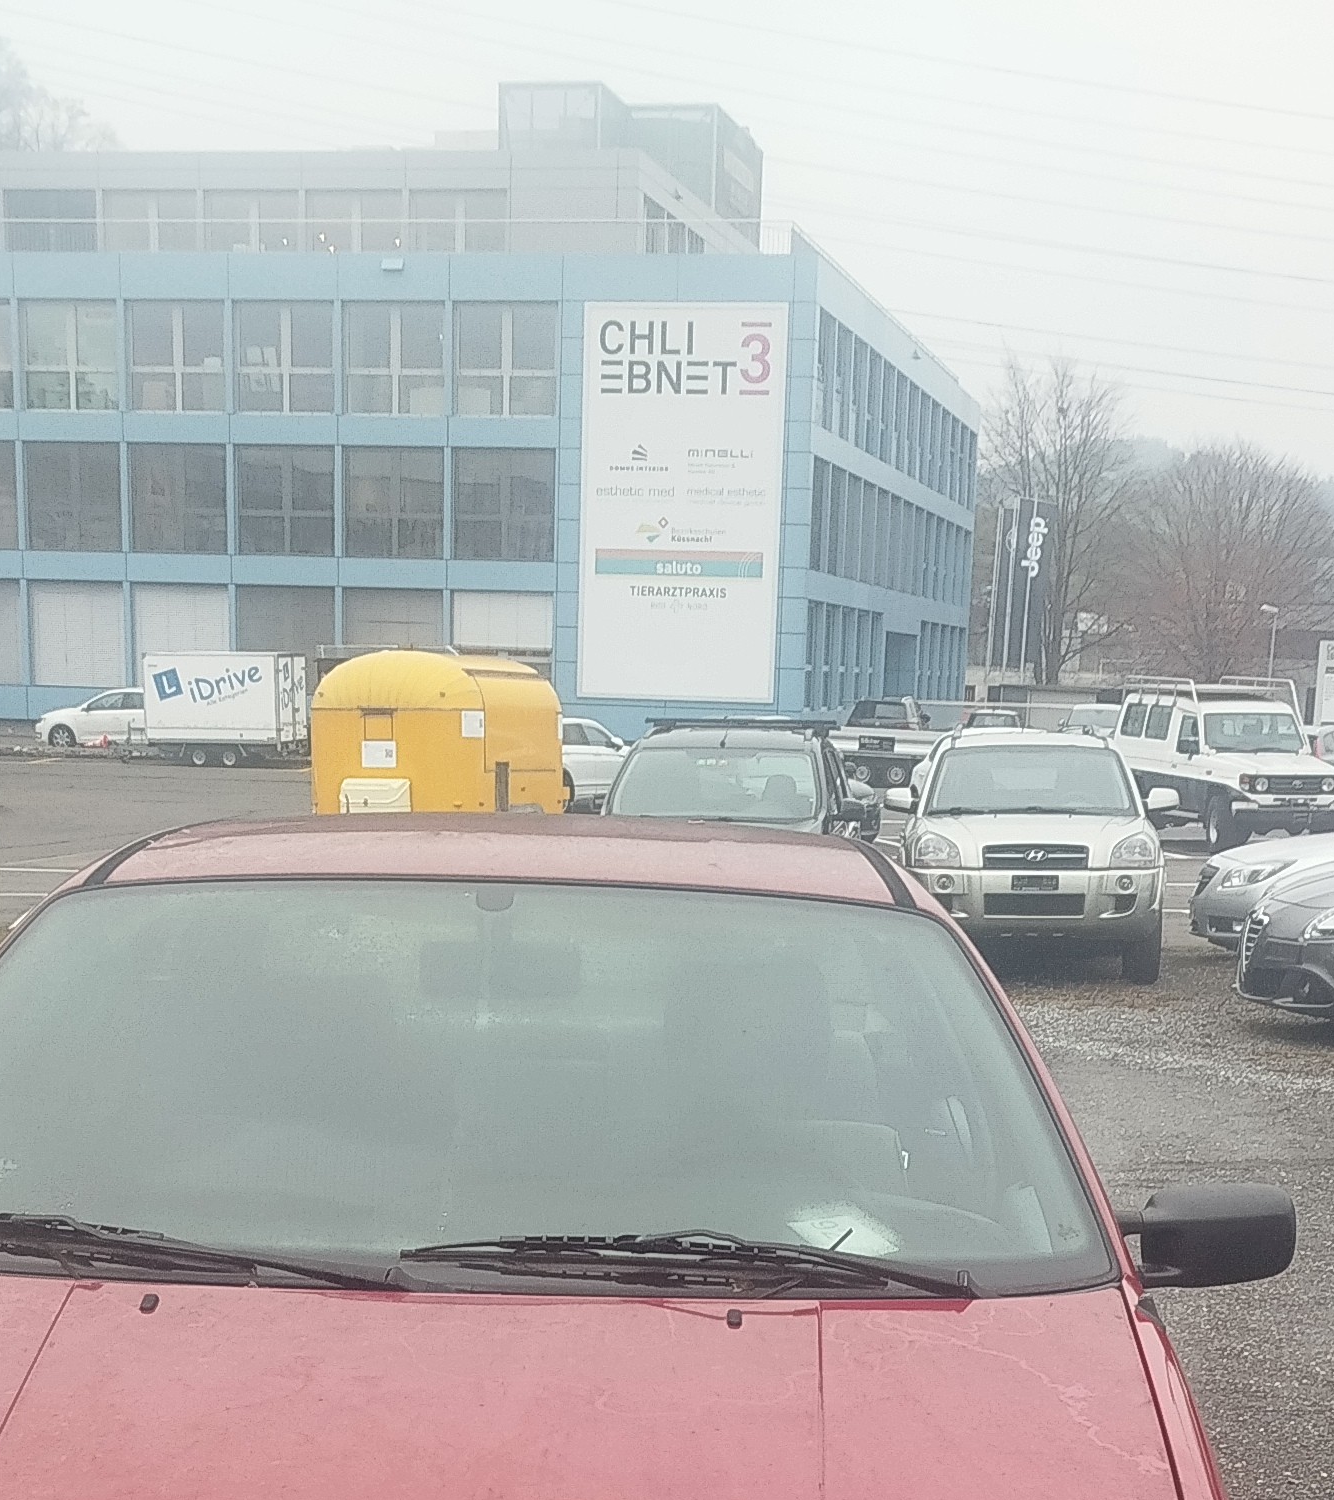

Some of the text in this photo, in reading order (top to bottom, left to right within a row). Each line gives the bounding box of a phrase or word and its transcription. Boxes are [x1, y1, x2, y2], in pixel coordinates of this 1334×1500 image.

[599, 320, 694, 355] CHLI
[600, 333, 771, 395] EBNET 3
[648, 486, 675, 497] med
[1021, 517, 1049, 577] Jeep
[656, 561, 702, 575] saluto
[629, 585, 727, 599] TIERARZTPRAXIS
[187, 665, 263, 703] iDrive
